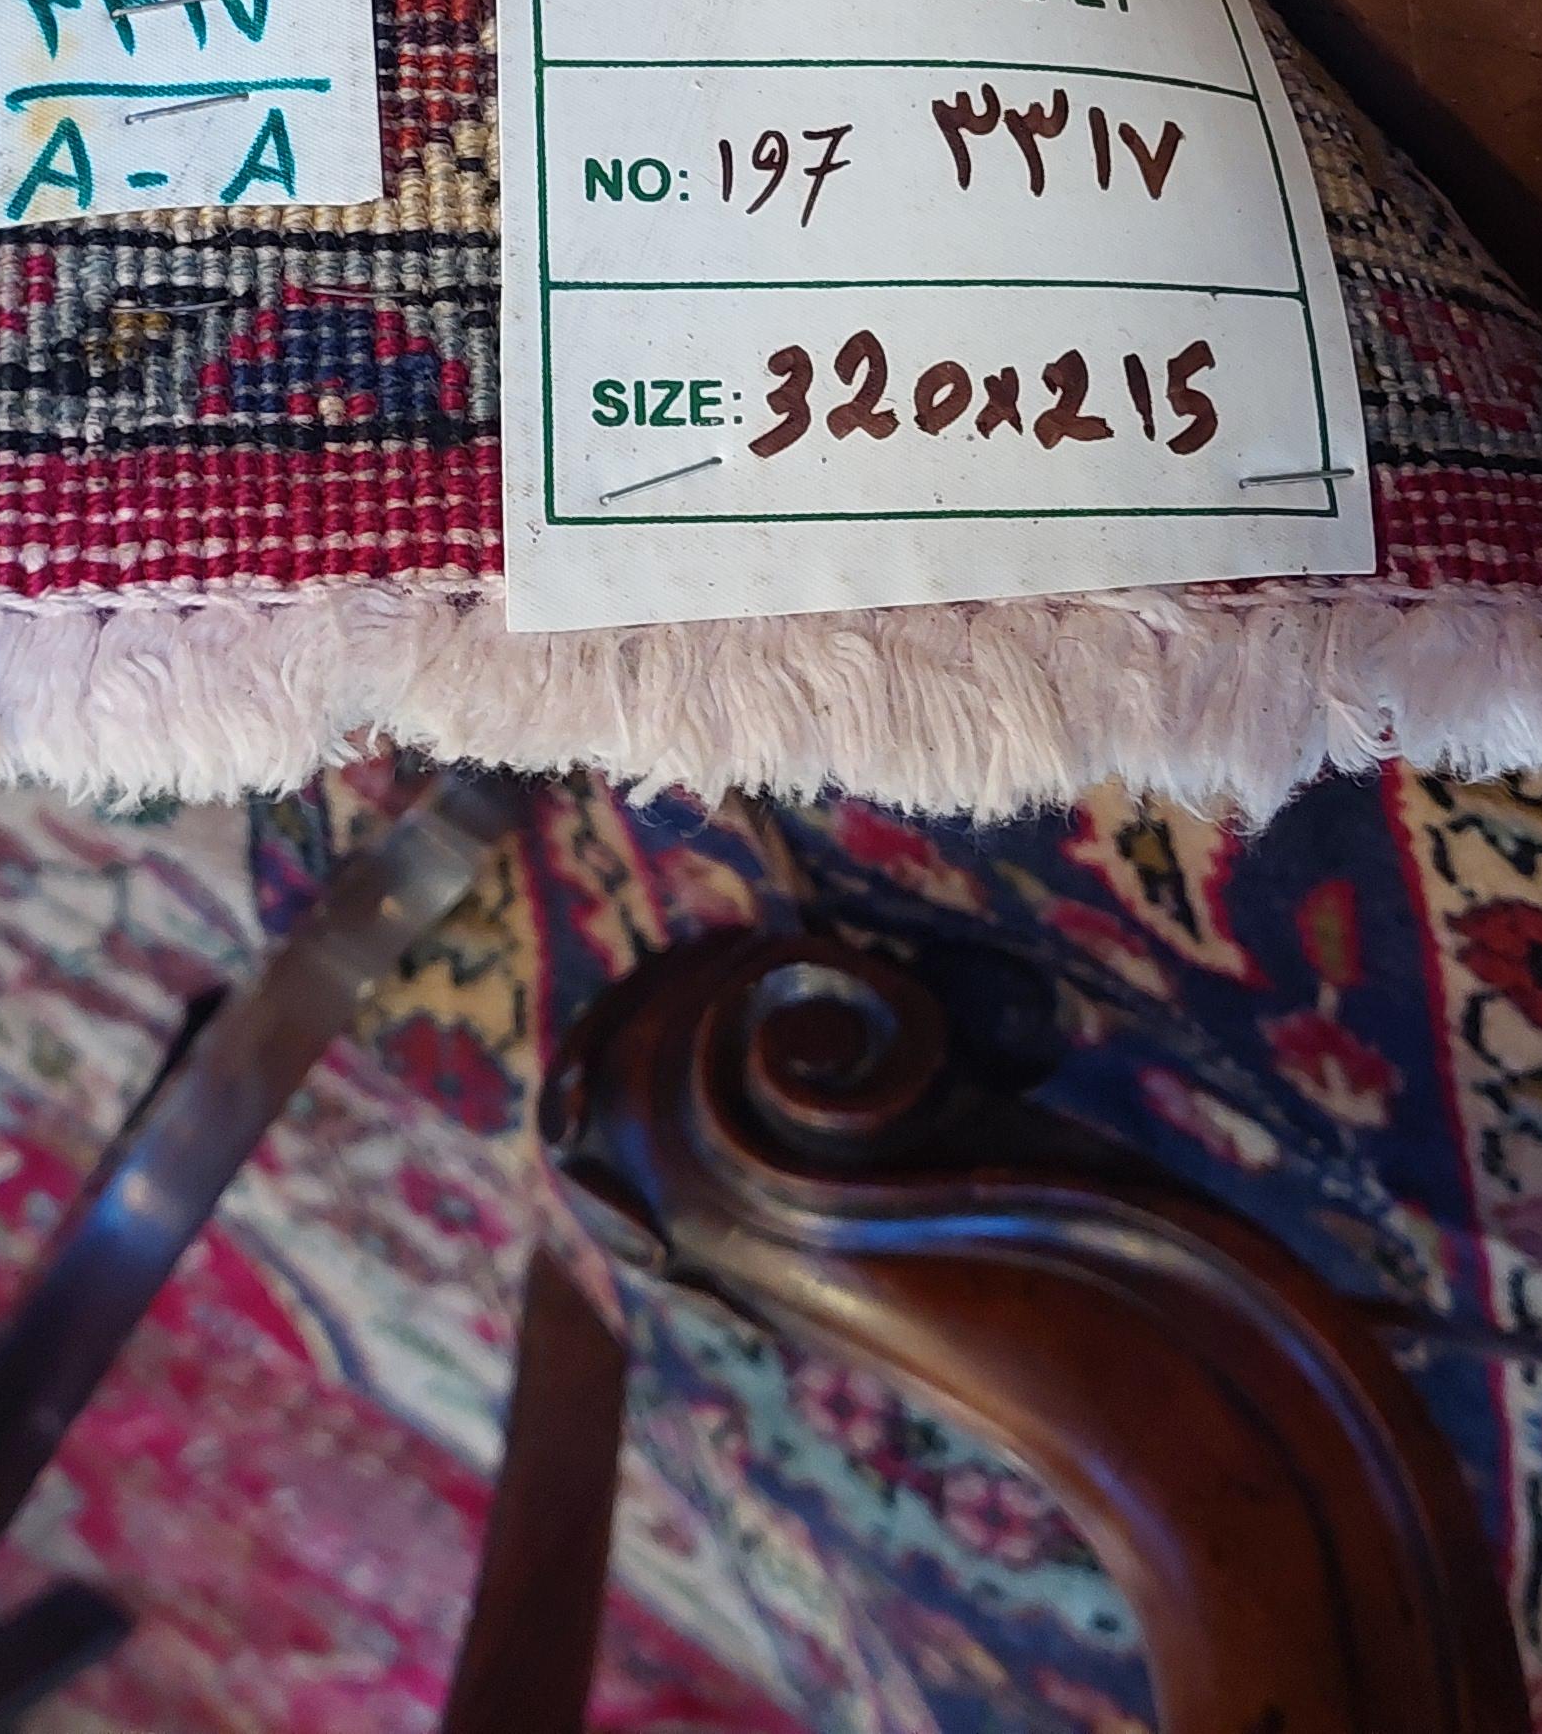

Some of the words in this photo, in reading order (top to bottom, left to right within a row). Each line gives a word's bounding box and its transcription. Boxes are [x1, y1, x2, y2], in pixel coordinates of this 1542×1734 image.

[585, 158, 689, 202] NO:
[718, 124, 853, 227] 197
[592, 379, 743, 427] SIZE:
